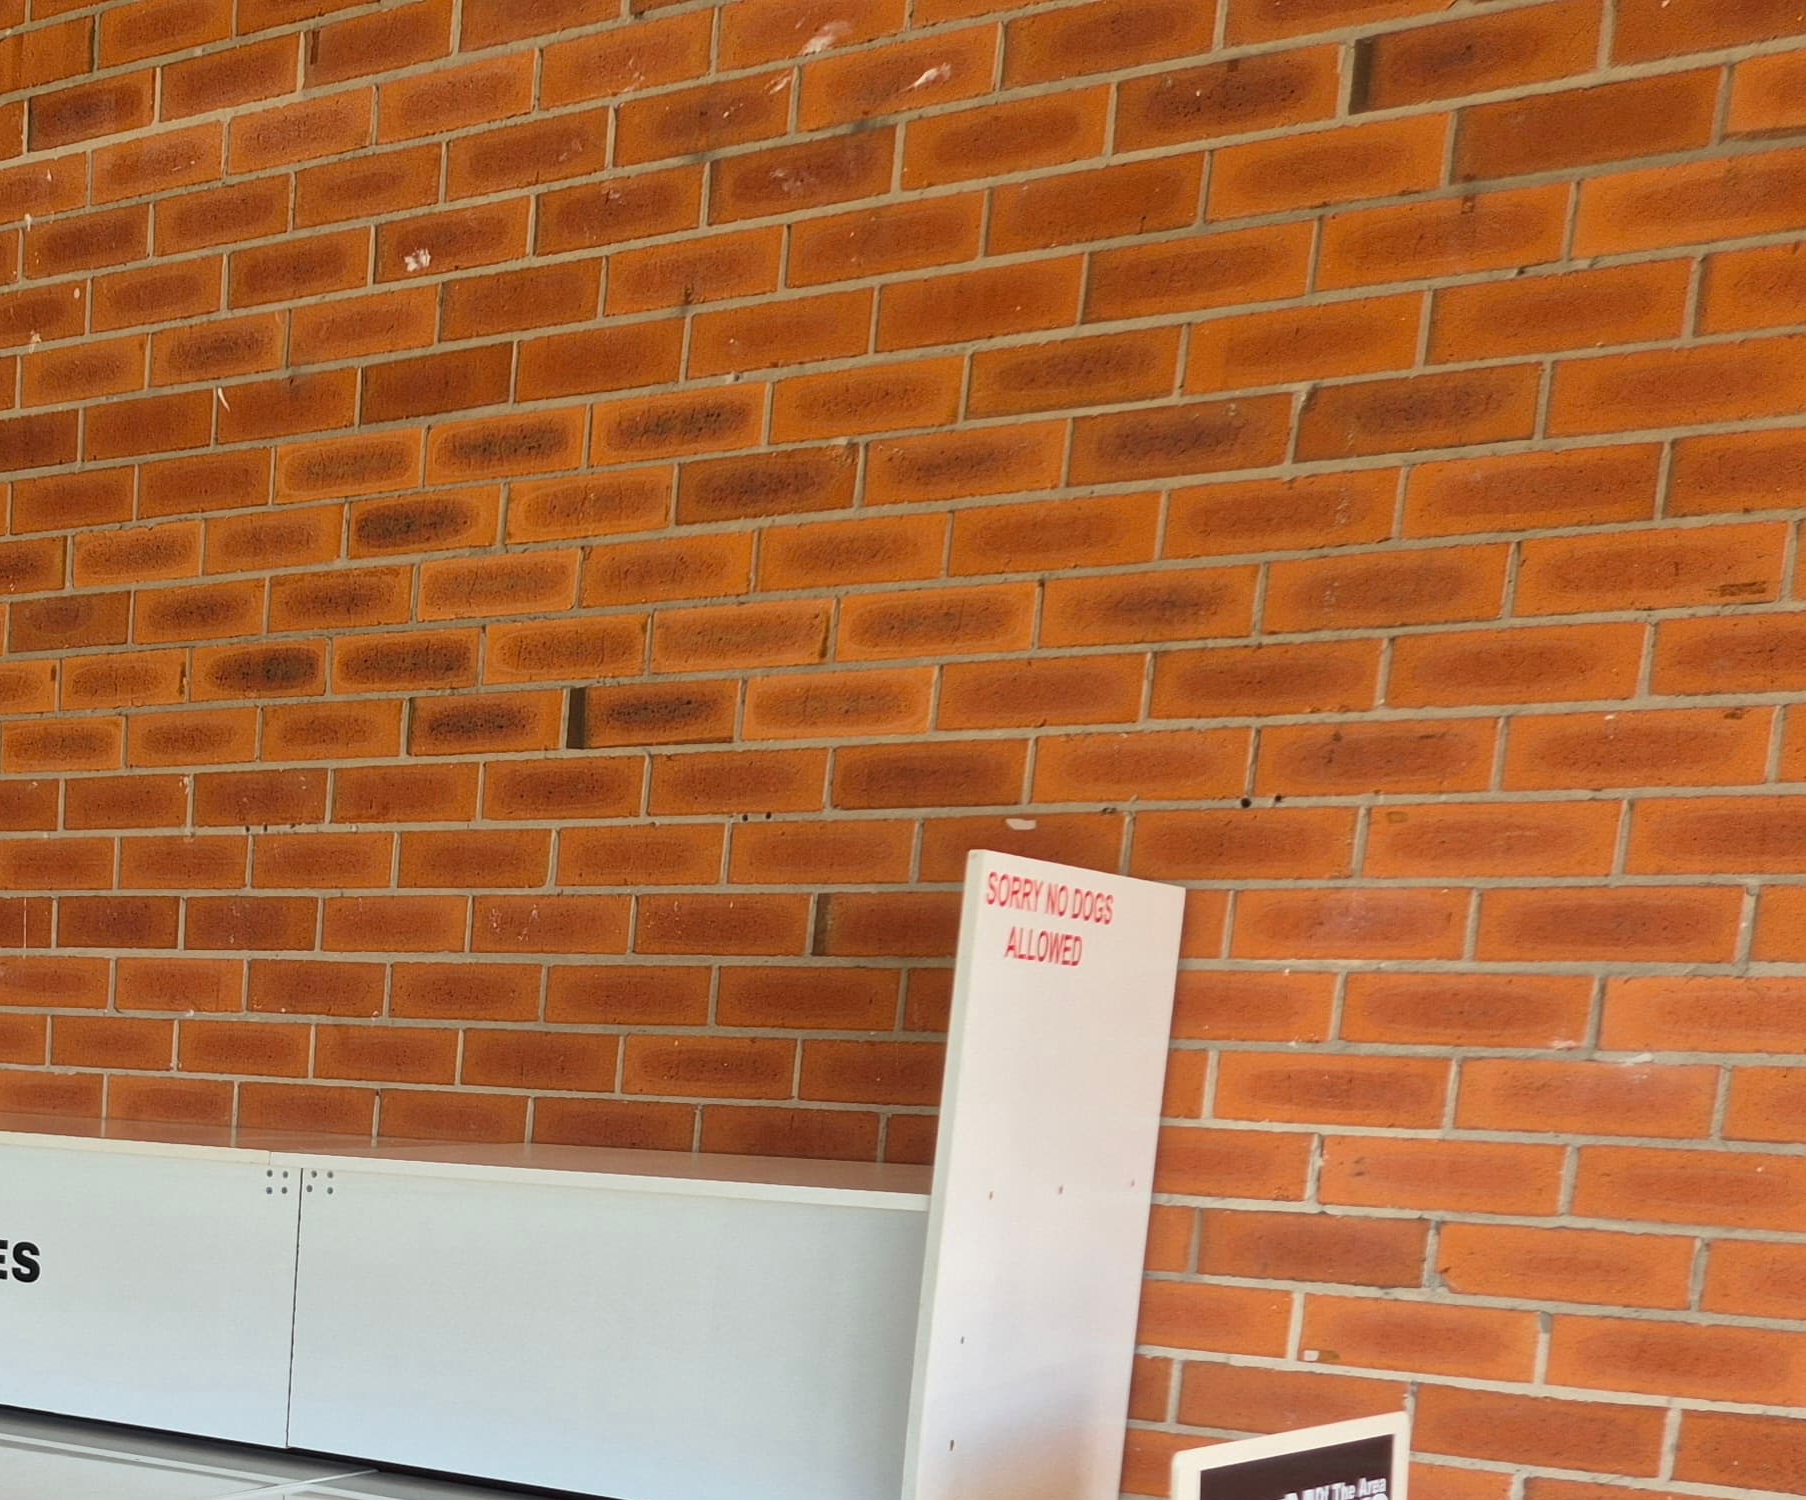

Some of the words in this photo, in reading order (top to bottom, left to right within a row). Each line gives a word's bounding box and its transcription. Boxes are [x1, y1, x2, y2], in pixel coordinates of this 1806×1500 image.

[986, 871, 1044, 912] SORRY
[1045, 881, 1069, 917] NO
[1071, 888, 1114, 925] DOGS
[1004, 926, 1083, 966] ALLOWED
[1356, 1477, 1387, 1498] Area
